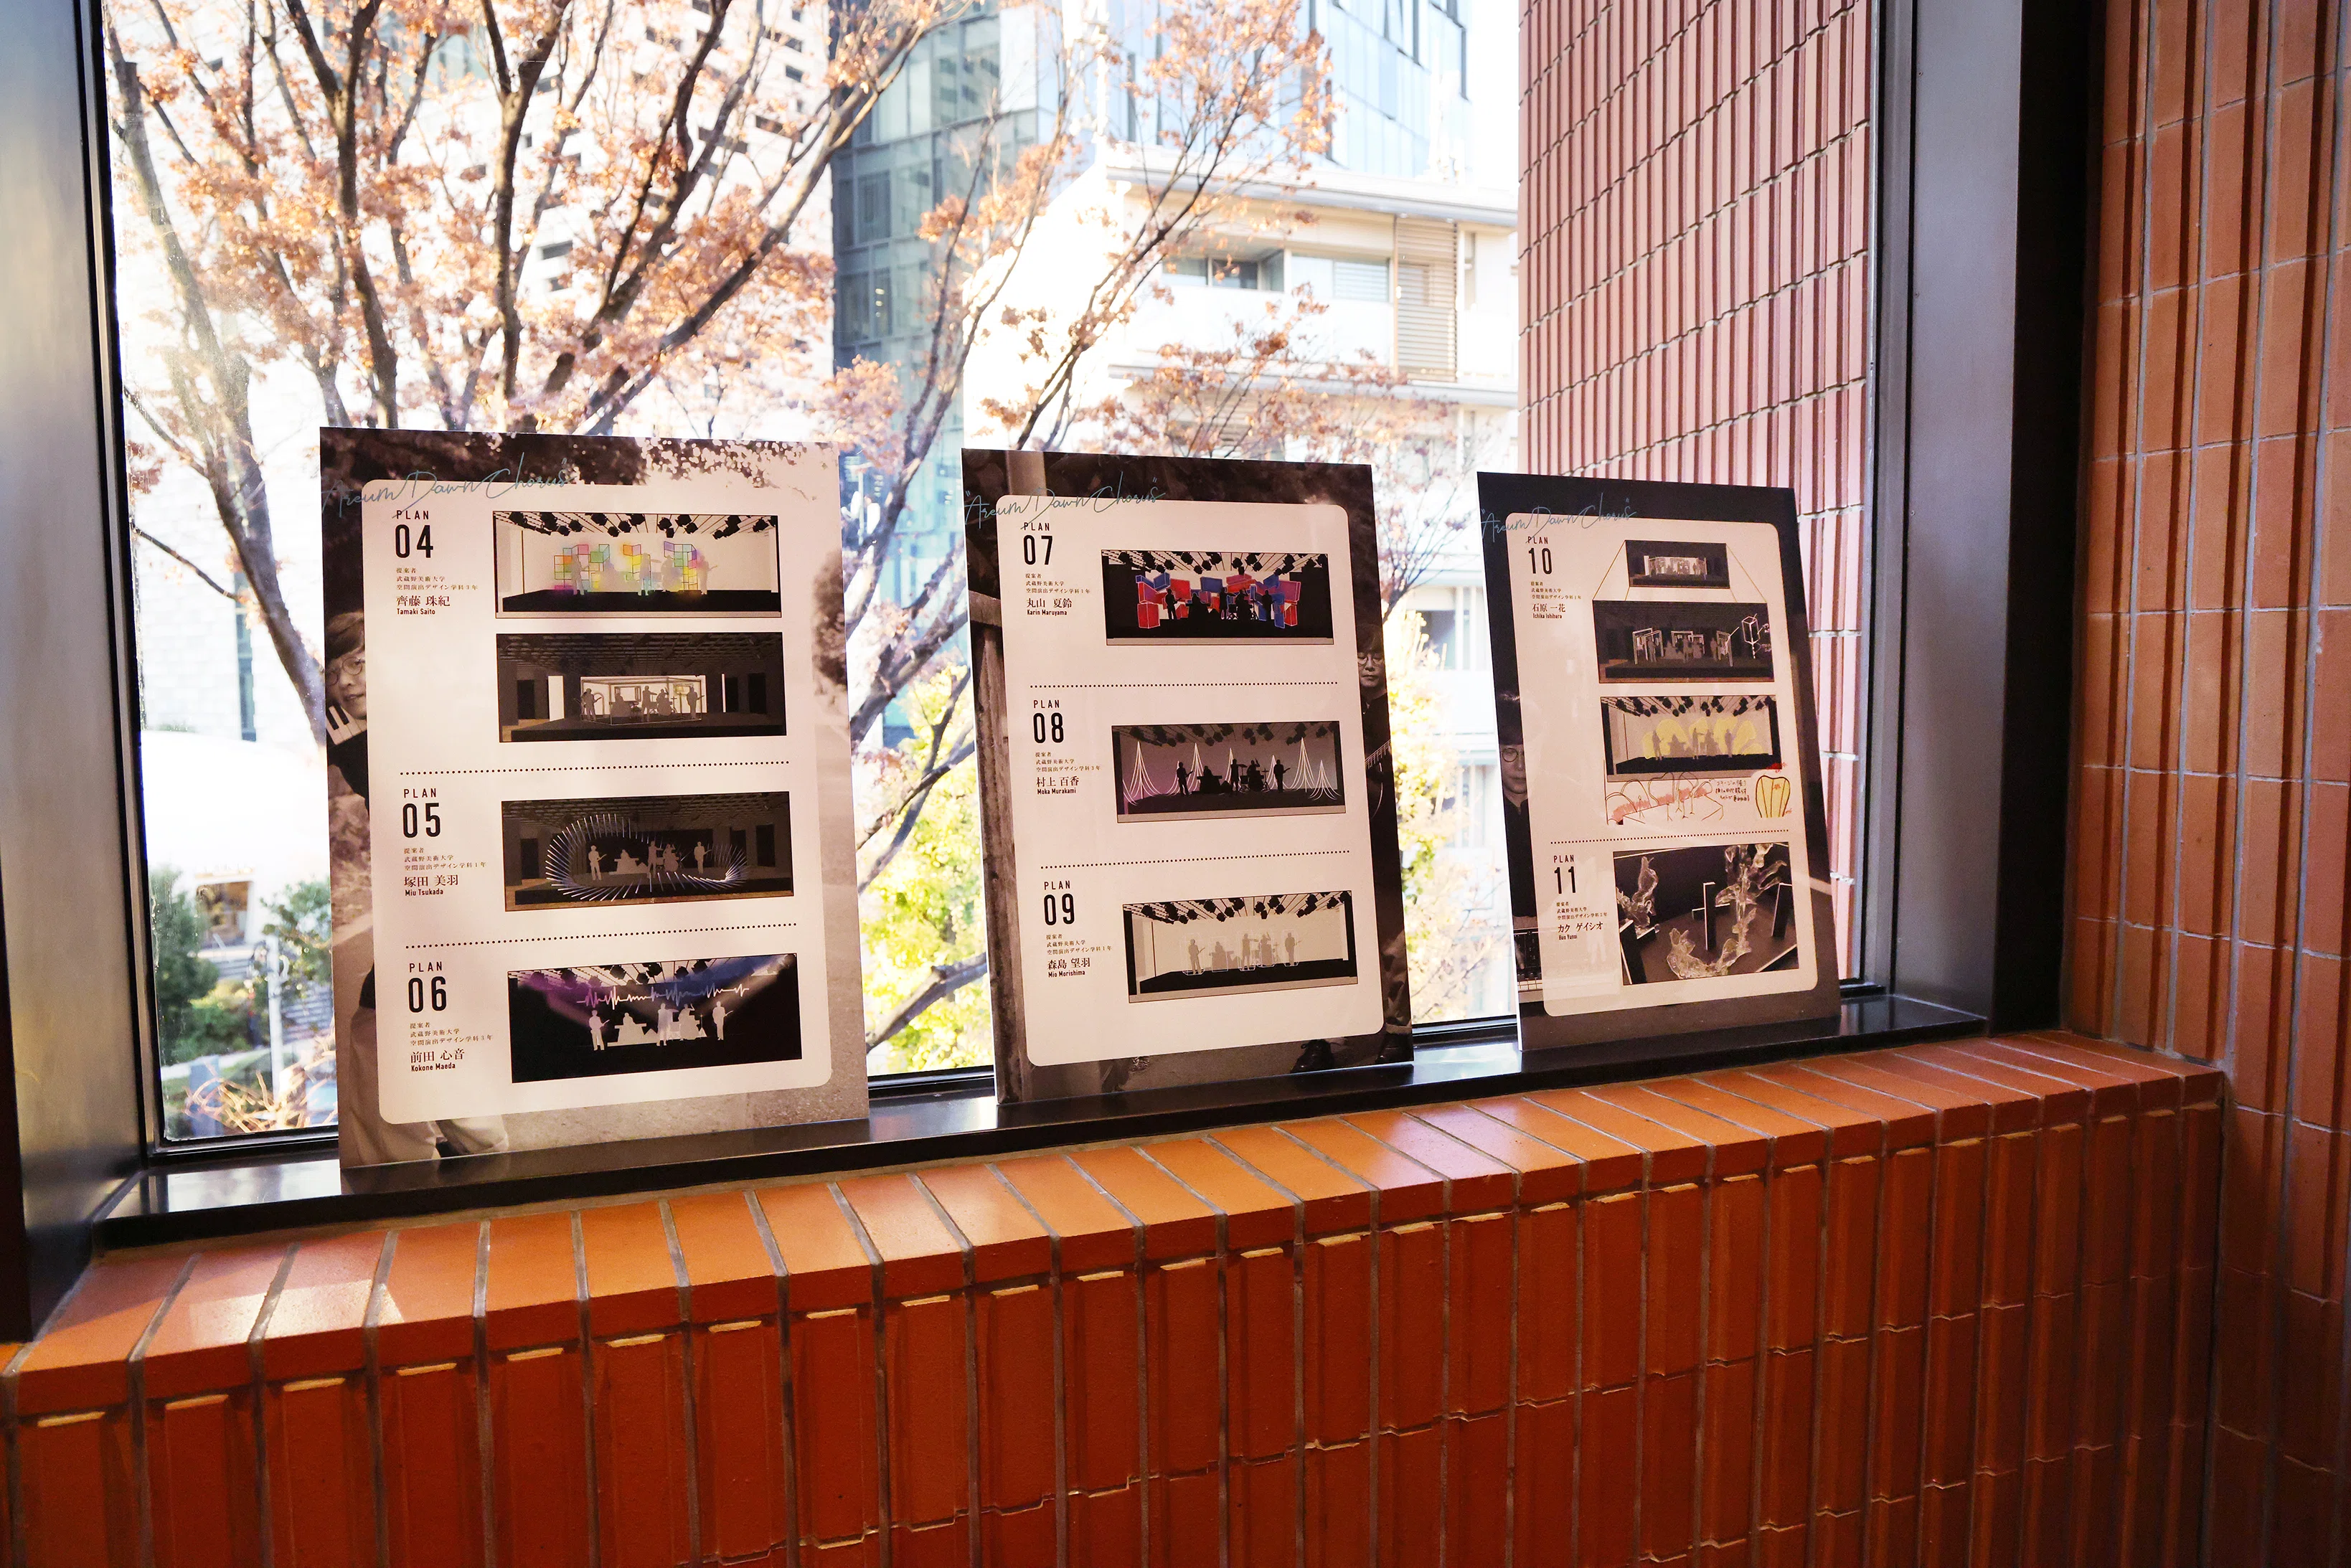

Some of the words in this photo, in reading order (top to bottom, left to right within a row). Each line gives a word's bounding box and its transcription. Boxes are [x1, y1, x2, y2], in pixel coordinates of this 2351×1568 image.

[392, 470, 476, 519] Dawn
[1020, 487, 1087, 529] Dawn
[396, 510, 429, 520] PLAN
[1024, 522, 1050, 531] PLAN
[1525, 505, 1577, 543] Dawn
[395, 524, 433, 558] 04
[1023, 534, 1053, 565] 07
[1528, 547, 1553, 575] 10
[1033, 712, 1064, 743] 08
[403, 788, 436, 798] PLAN
[402, 803, 440, 839] 05
[1044, 880, 1070, 890] PLAN
[1554, 866, 1575, 894] 11
[1044, 893, 1075, 925] 09
[1558, 924, 1570, 933] カク
[1575, 921, 1603, 932] ゲイシオ
[409, 961, 442, 973] PLAN
[408, 976, 446, 1013] 06
